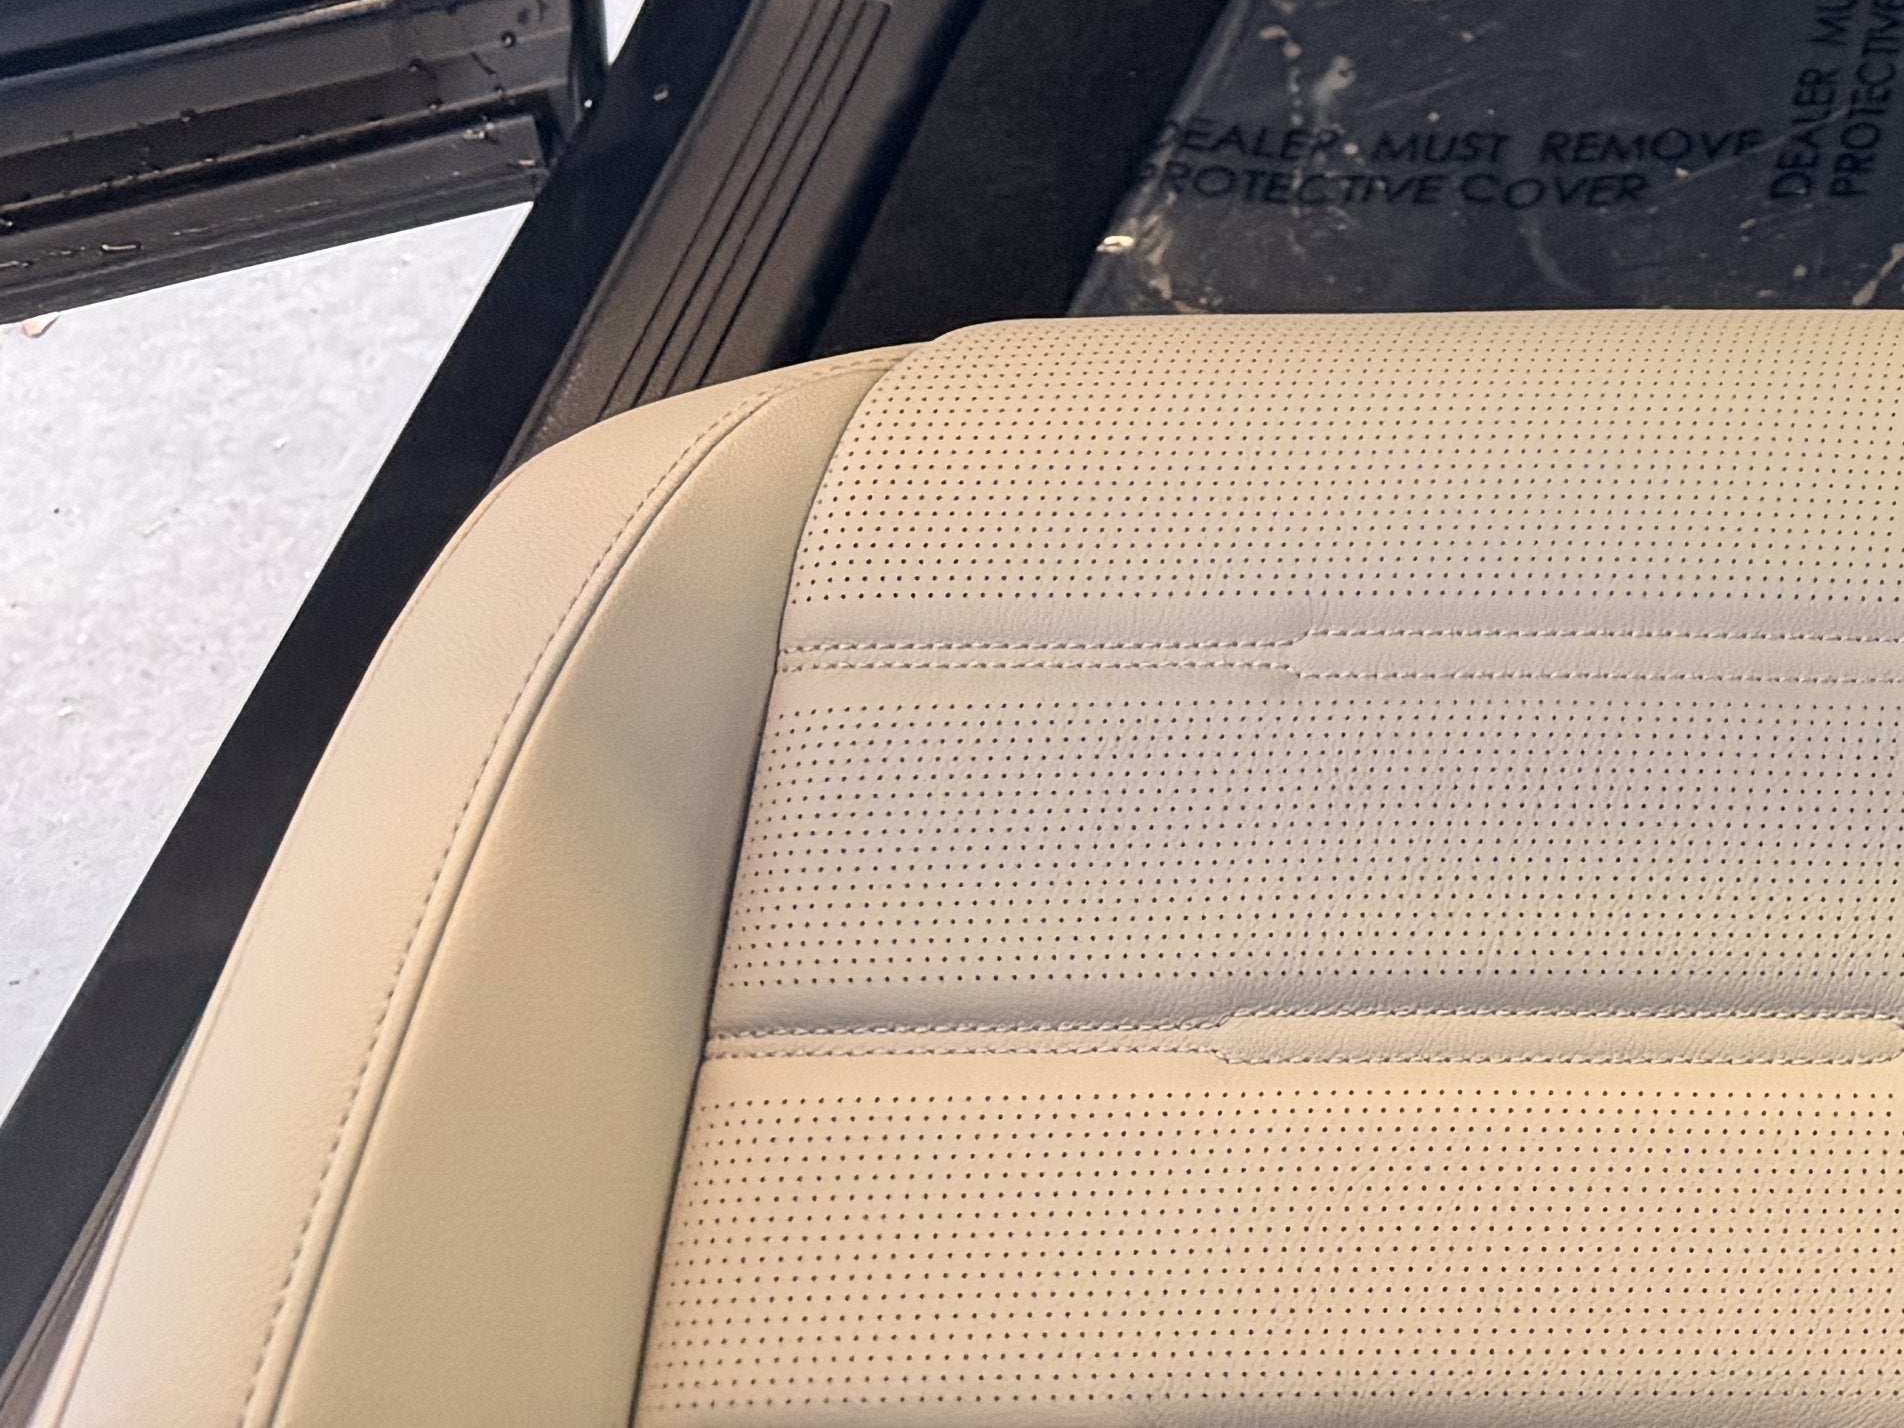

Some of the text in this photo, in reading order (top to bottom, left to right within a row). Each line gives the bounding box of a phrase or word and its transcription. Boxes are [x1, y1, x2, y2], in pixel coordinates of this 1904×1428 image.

[1371, 130, 1509, 165] MUST
[1539, 127, 1762, 165] REMOVE
[1769, 65, 1839, 200] DEALER
[1459, 172, 1648, 210] COVER
